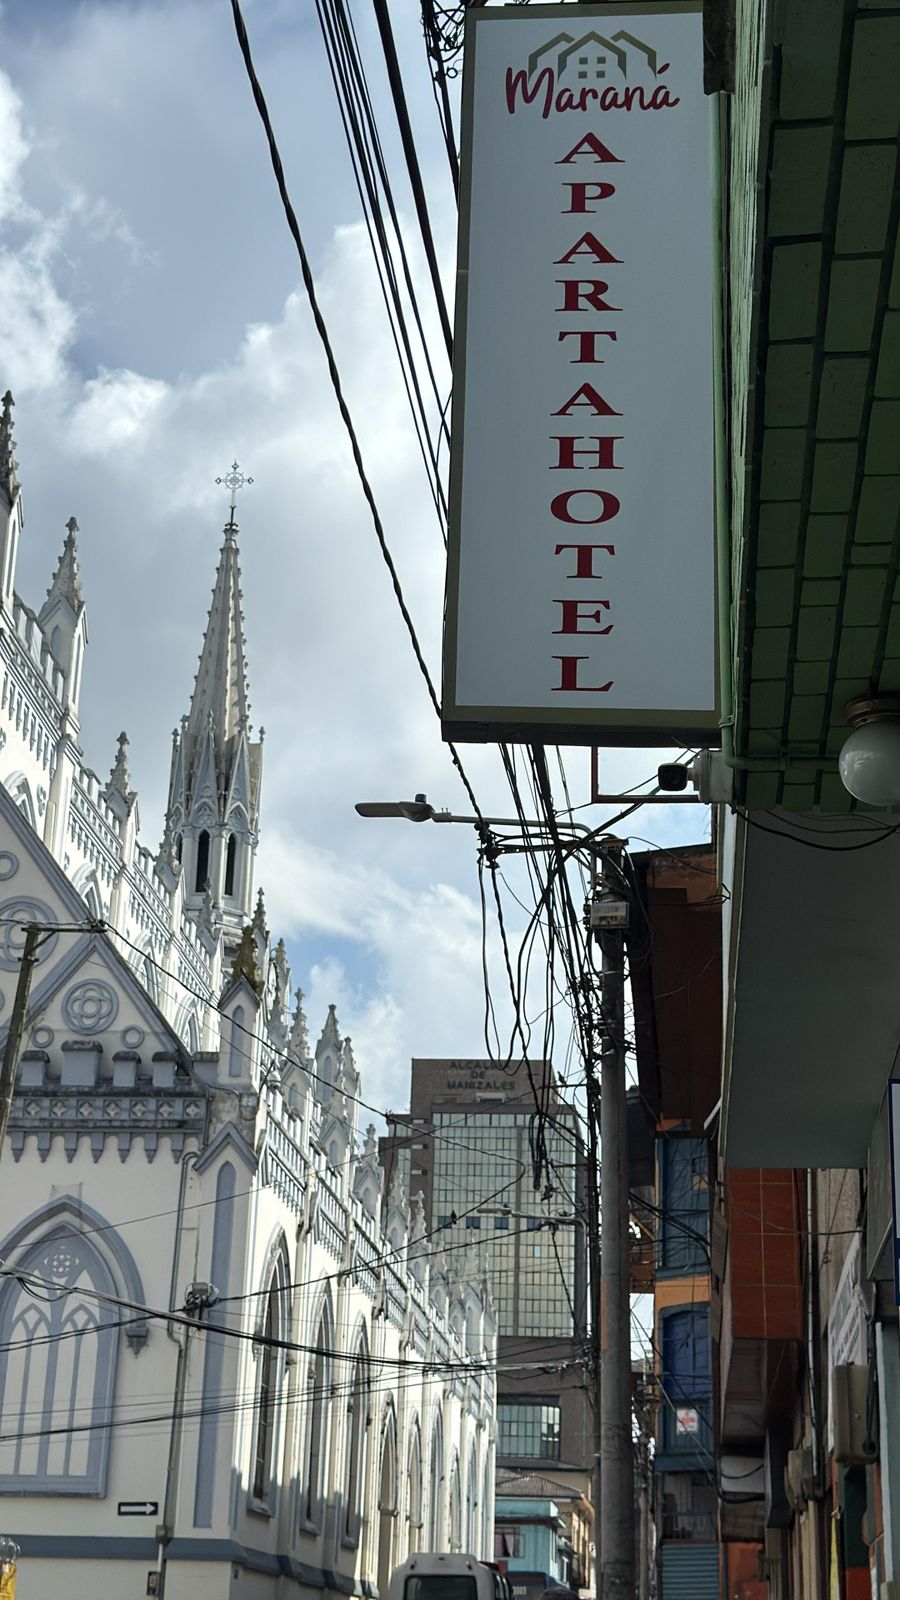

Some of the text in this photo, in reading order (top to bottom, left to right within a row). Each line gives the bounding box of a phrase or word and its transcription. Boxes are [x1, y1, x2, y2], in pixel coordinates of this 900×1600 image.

[505, 63, 681, 120] Maraná
[548, 131, 626, 692] APARTAHOTEL
[447, 1080, 515, 1090] MANIZALES
[471, 1070, 486, 1079] DE
